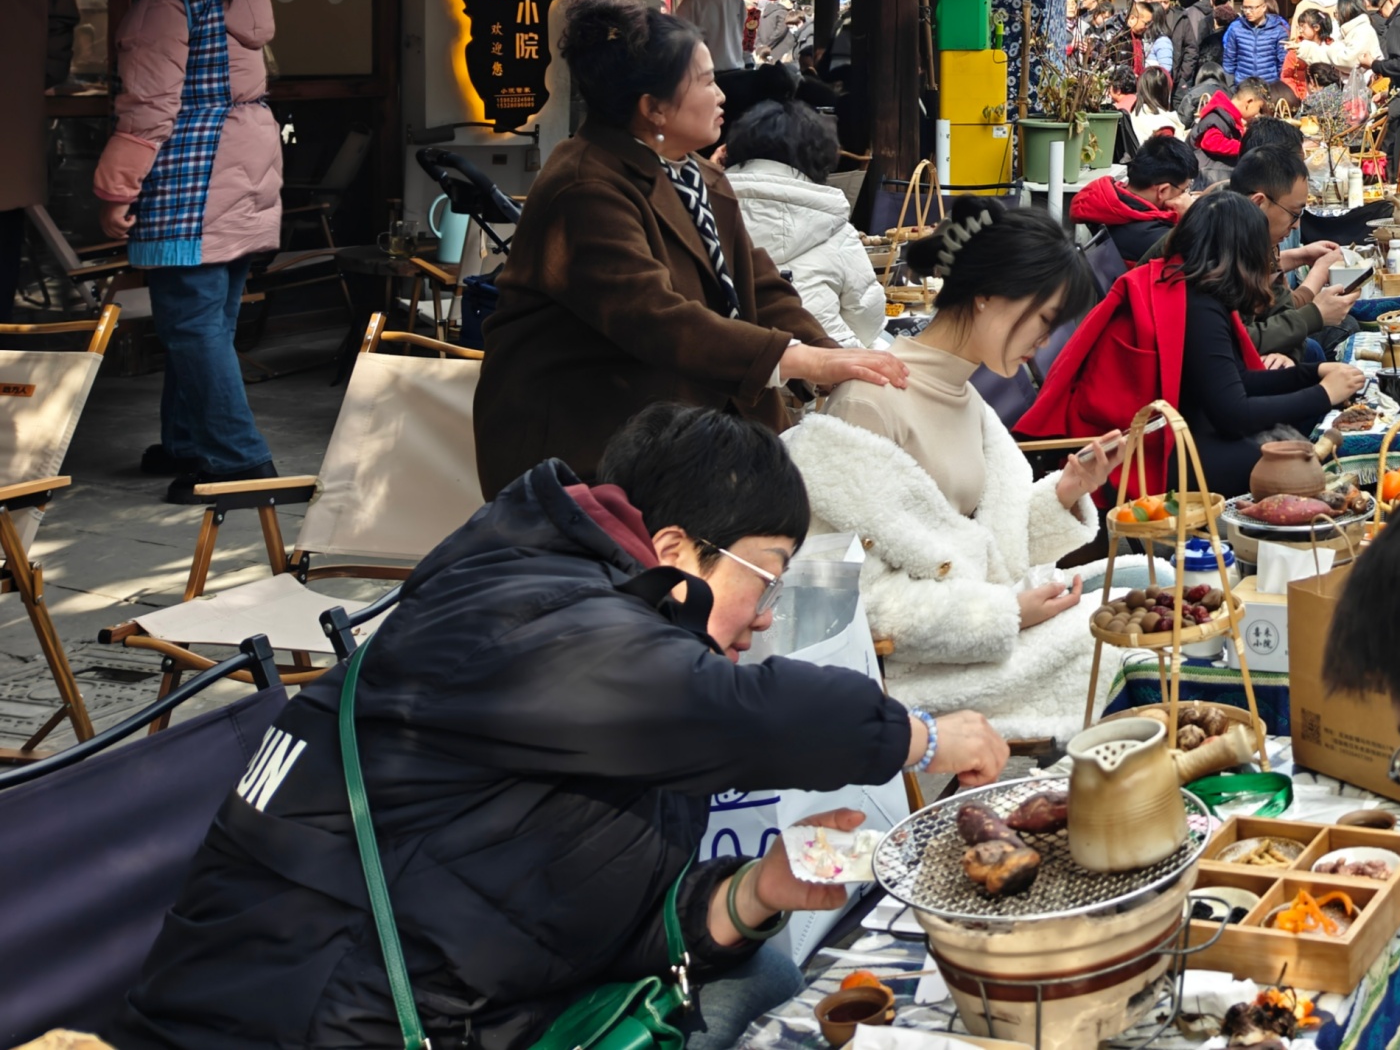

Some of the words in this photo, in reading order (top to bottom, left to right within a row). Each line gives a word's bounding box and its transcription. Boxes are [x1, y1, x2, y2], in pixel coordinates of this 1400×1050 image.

[491, 22, 503, 77] 欢迎您
[516, 0, 539, 59] 小院
